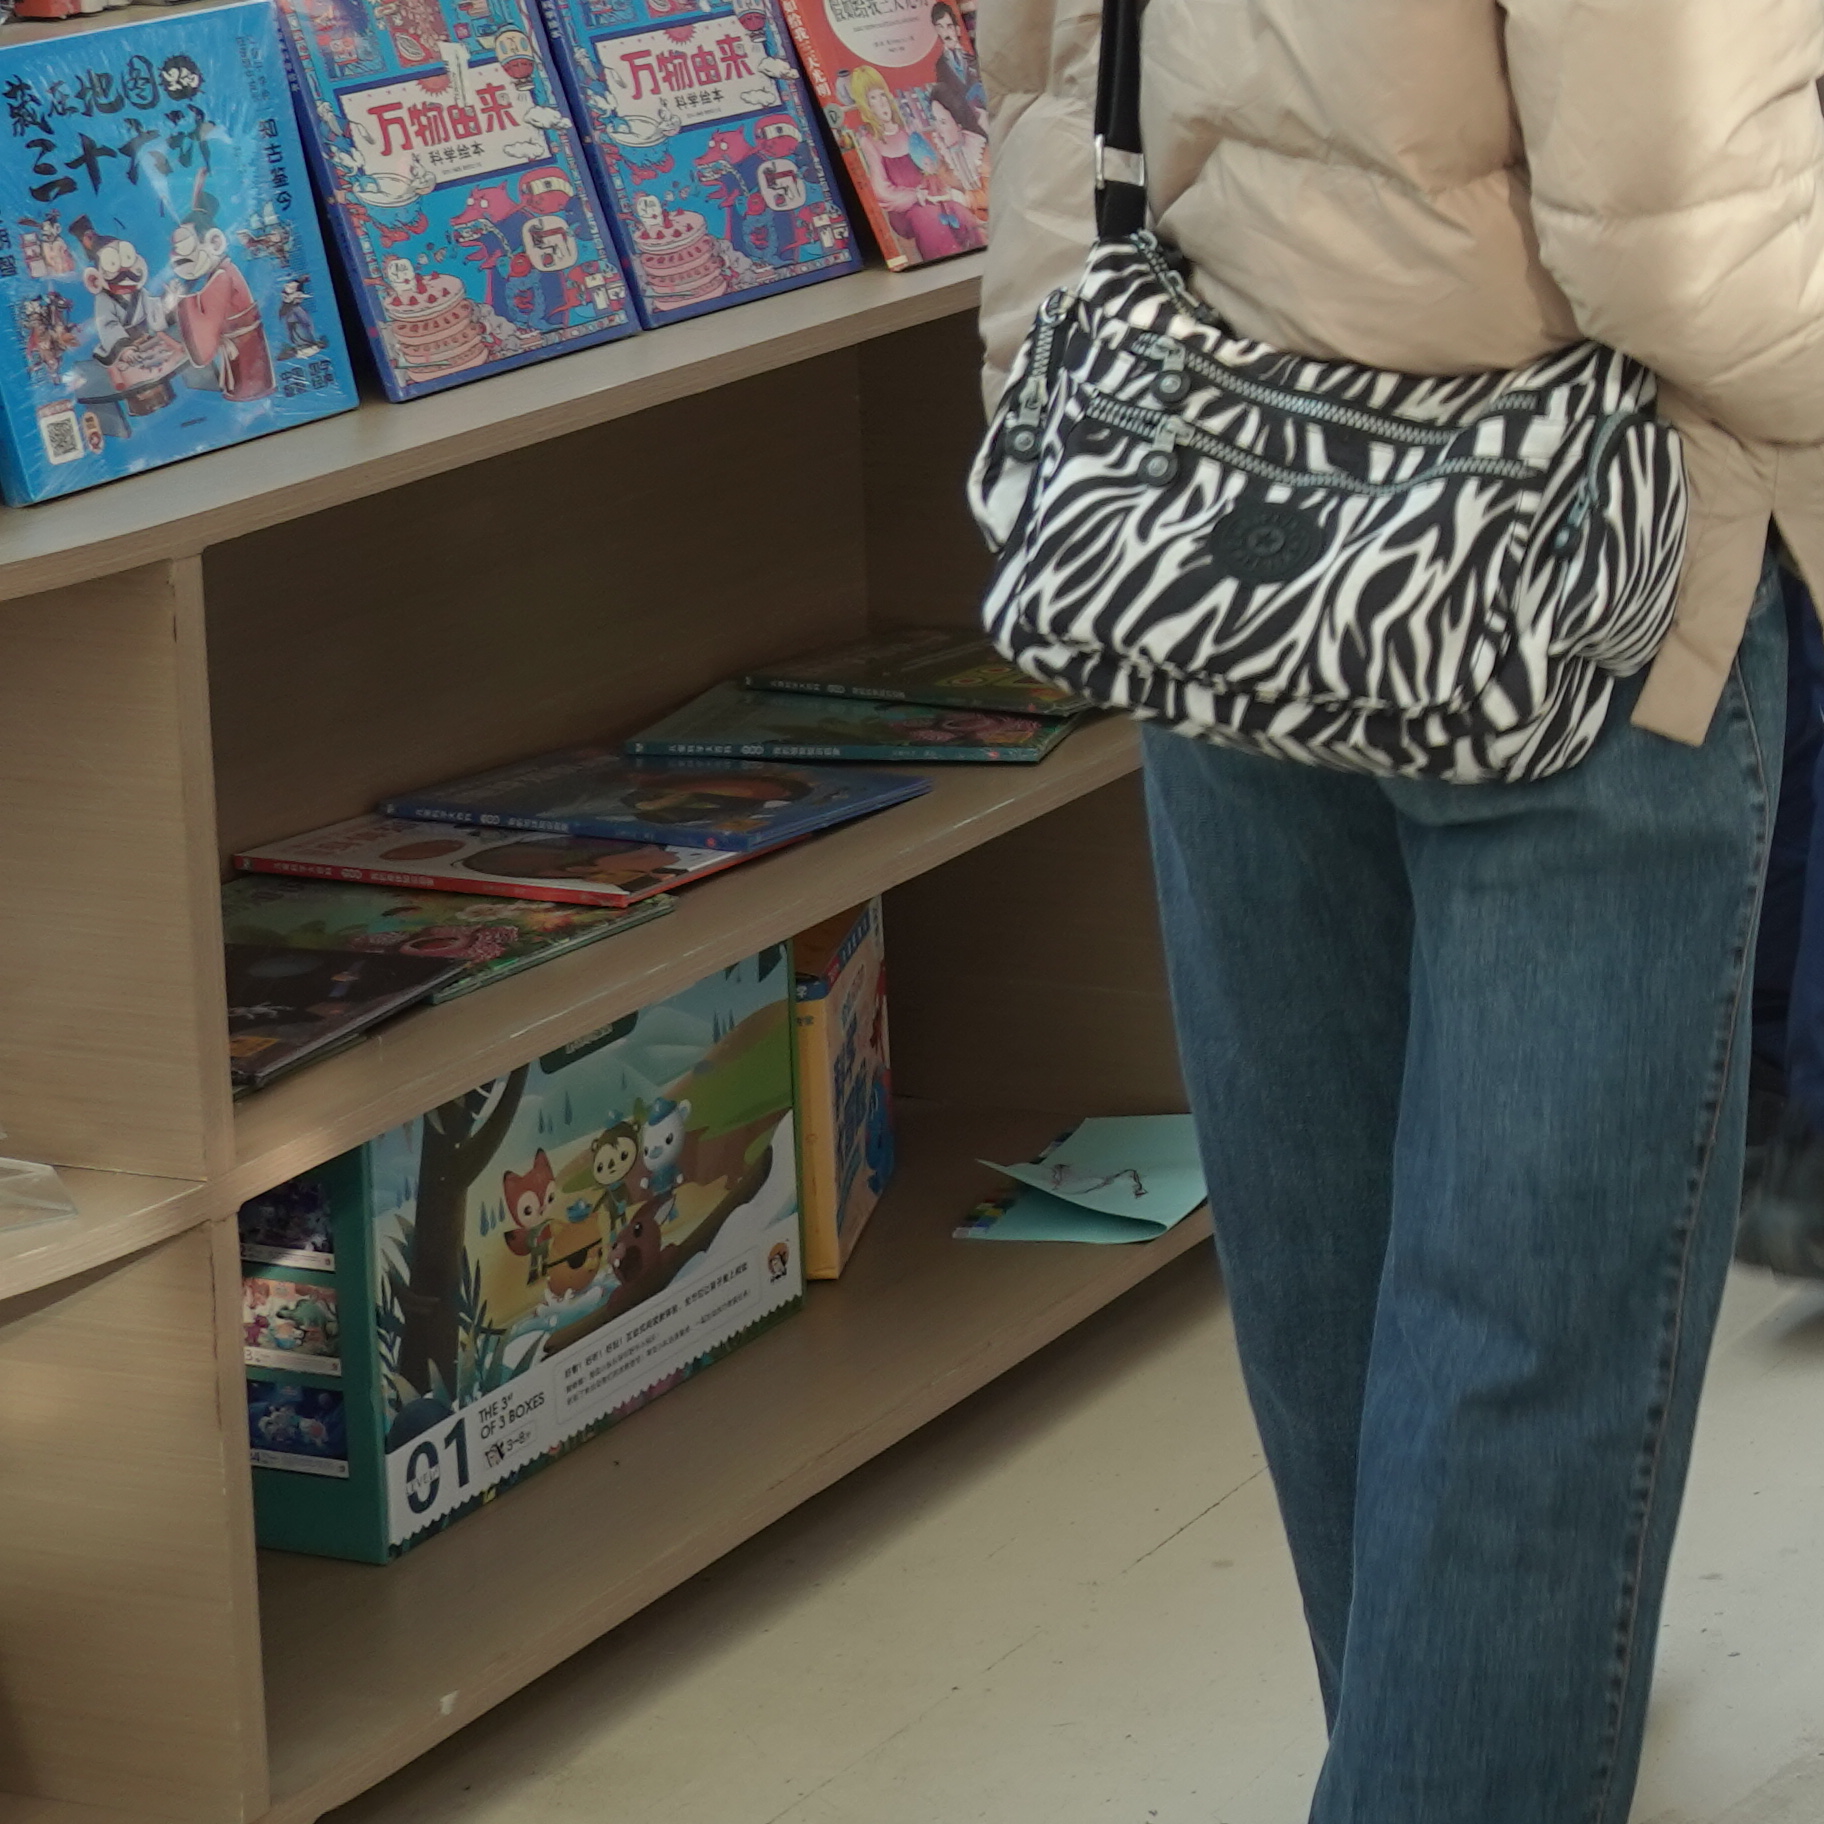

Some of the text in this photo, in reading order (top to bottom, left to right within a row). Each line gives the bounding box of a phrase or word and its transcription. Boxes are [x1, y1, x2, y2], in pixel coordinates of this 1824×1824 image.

[620, 33, 755, 100] 万物由来
[367, 82, 521, 157] 万物由来
[674, 87, 725, 111] 科学绘本
[25, 103, 216, 203] 三十六计
[428, 140, 486, 166] 科学绘本
[478, 1405, 500, 1424] THE
[480, 1391, 545, 1440] OF 3 BOXES
[406, 1417, 470, 1515] 01
